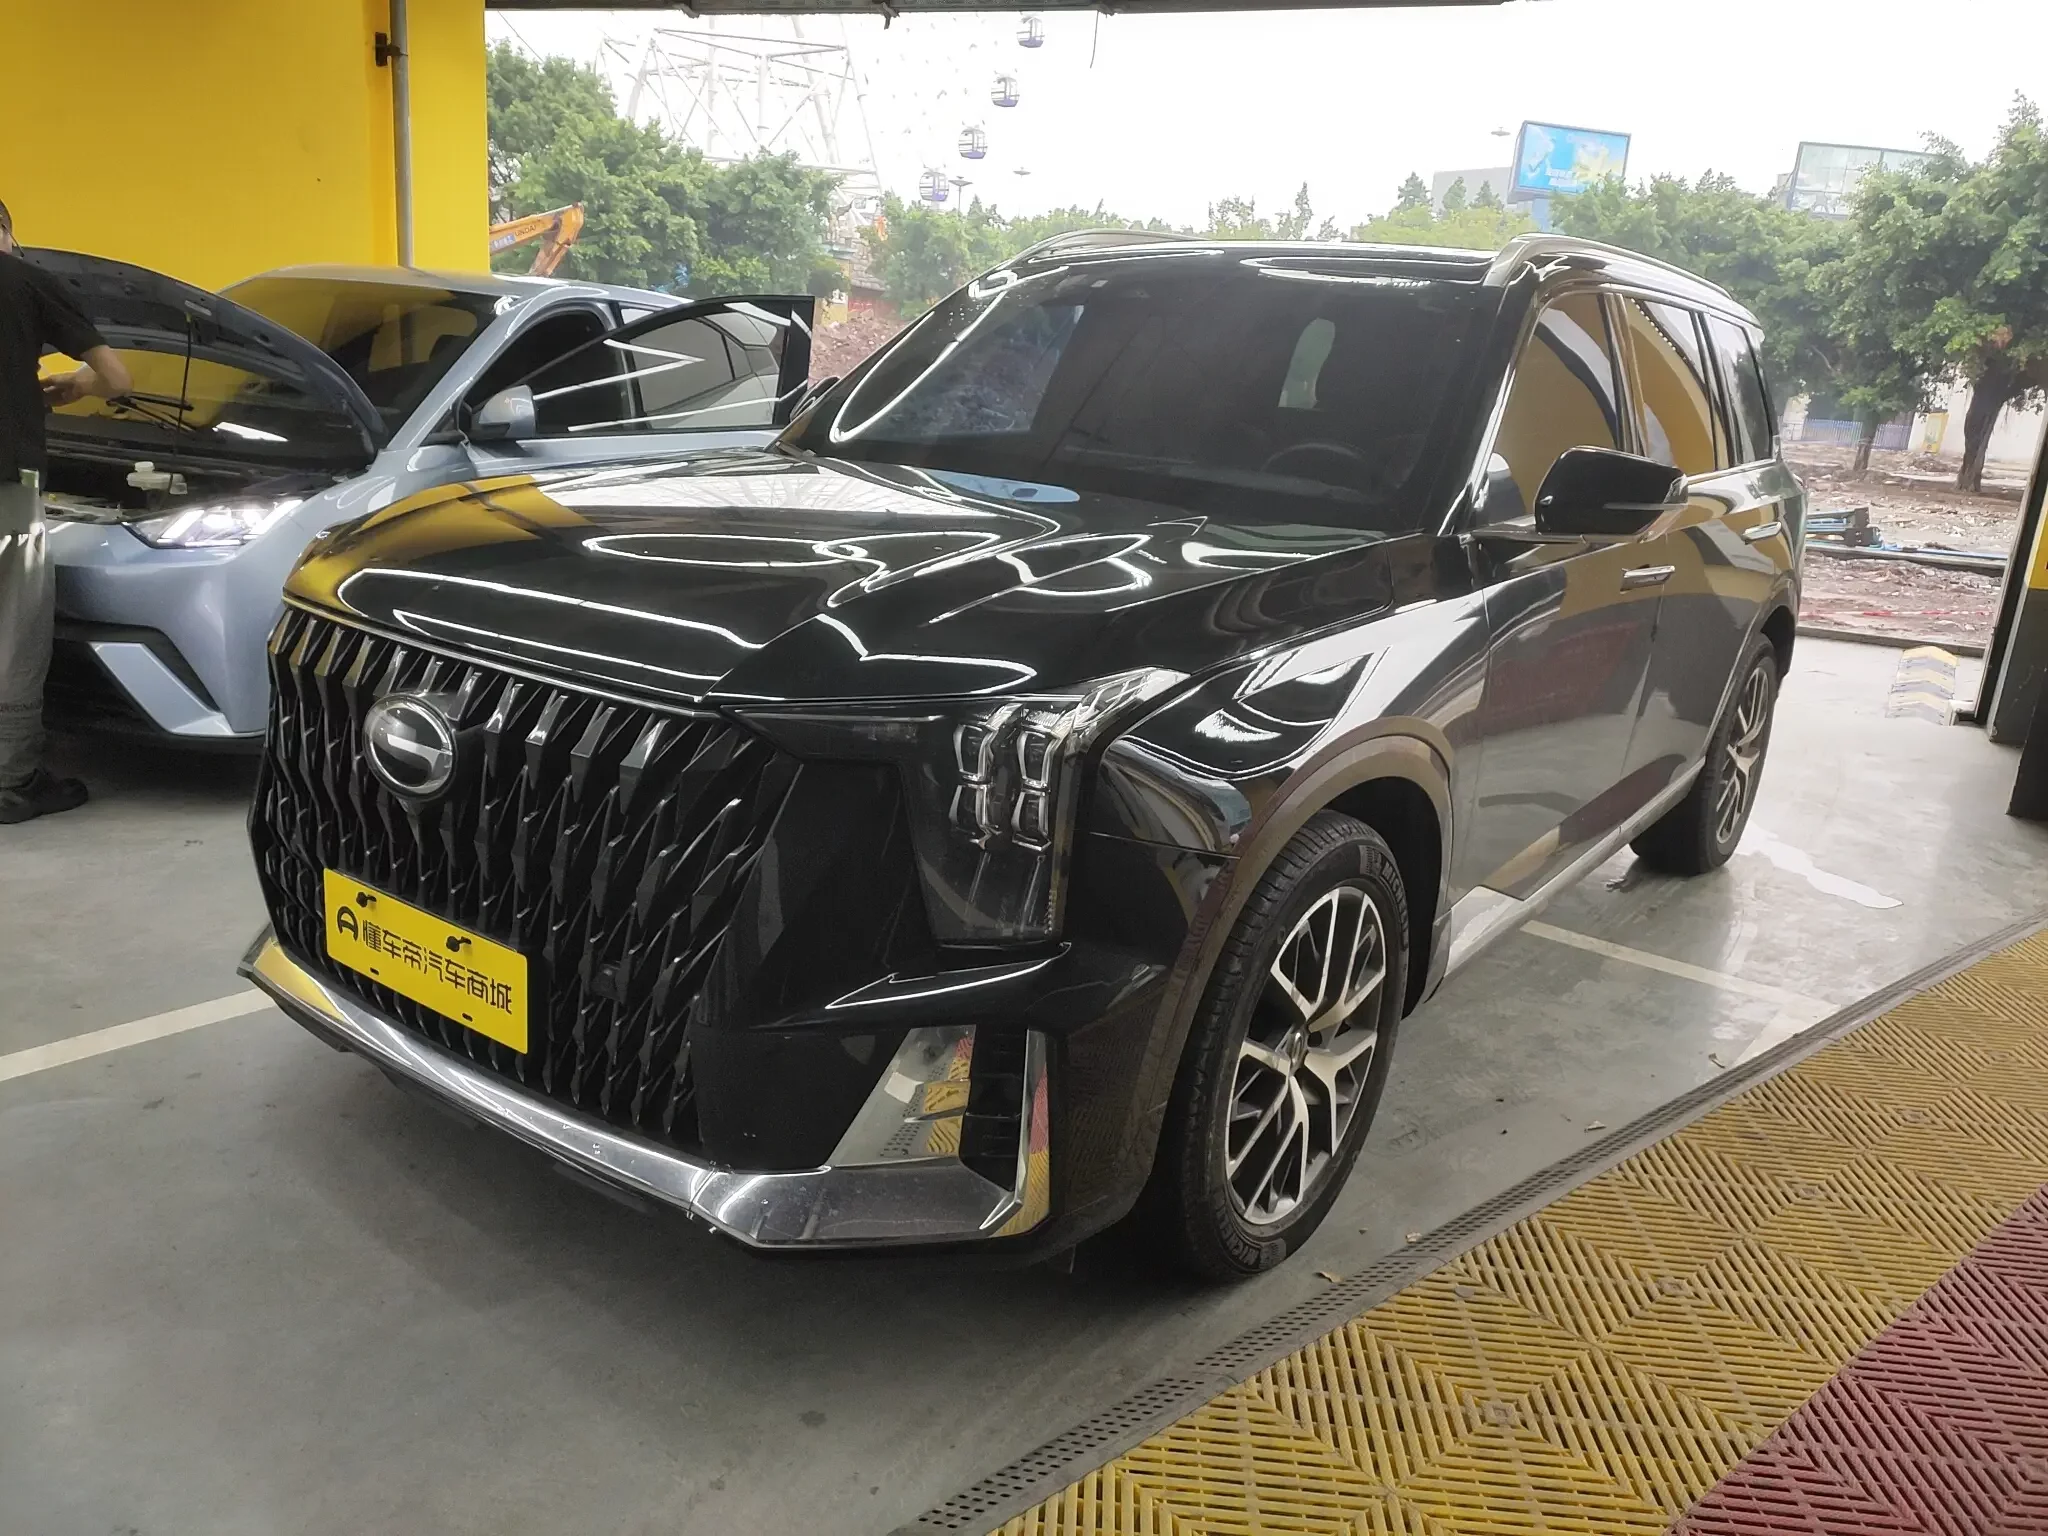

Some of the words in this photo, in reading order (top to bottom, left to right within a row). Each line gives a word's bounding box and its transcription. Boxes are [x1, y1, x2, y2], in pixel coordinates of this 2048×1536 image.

[362, 919, 513, 1015] 懂车帝汽车商城
